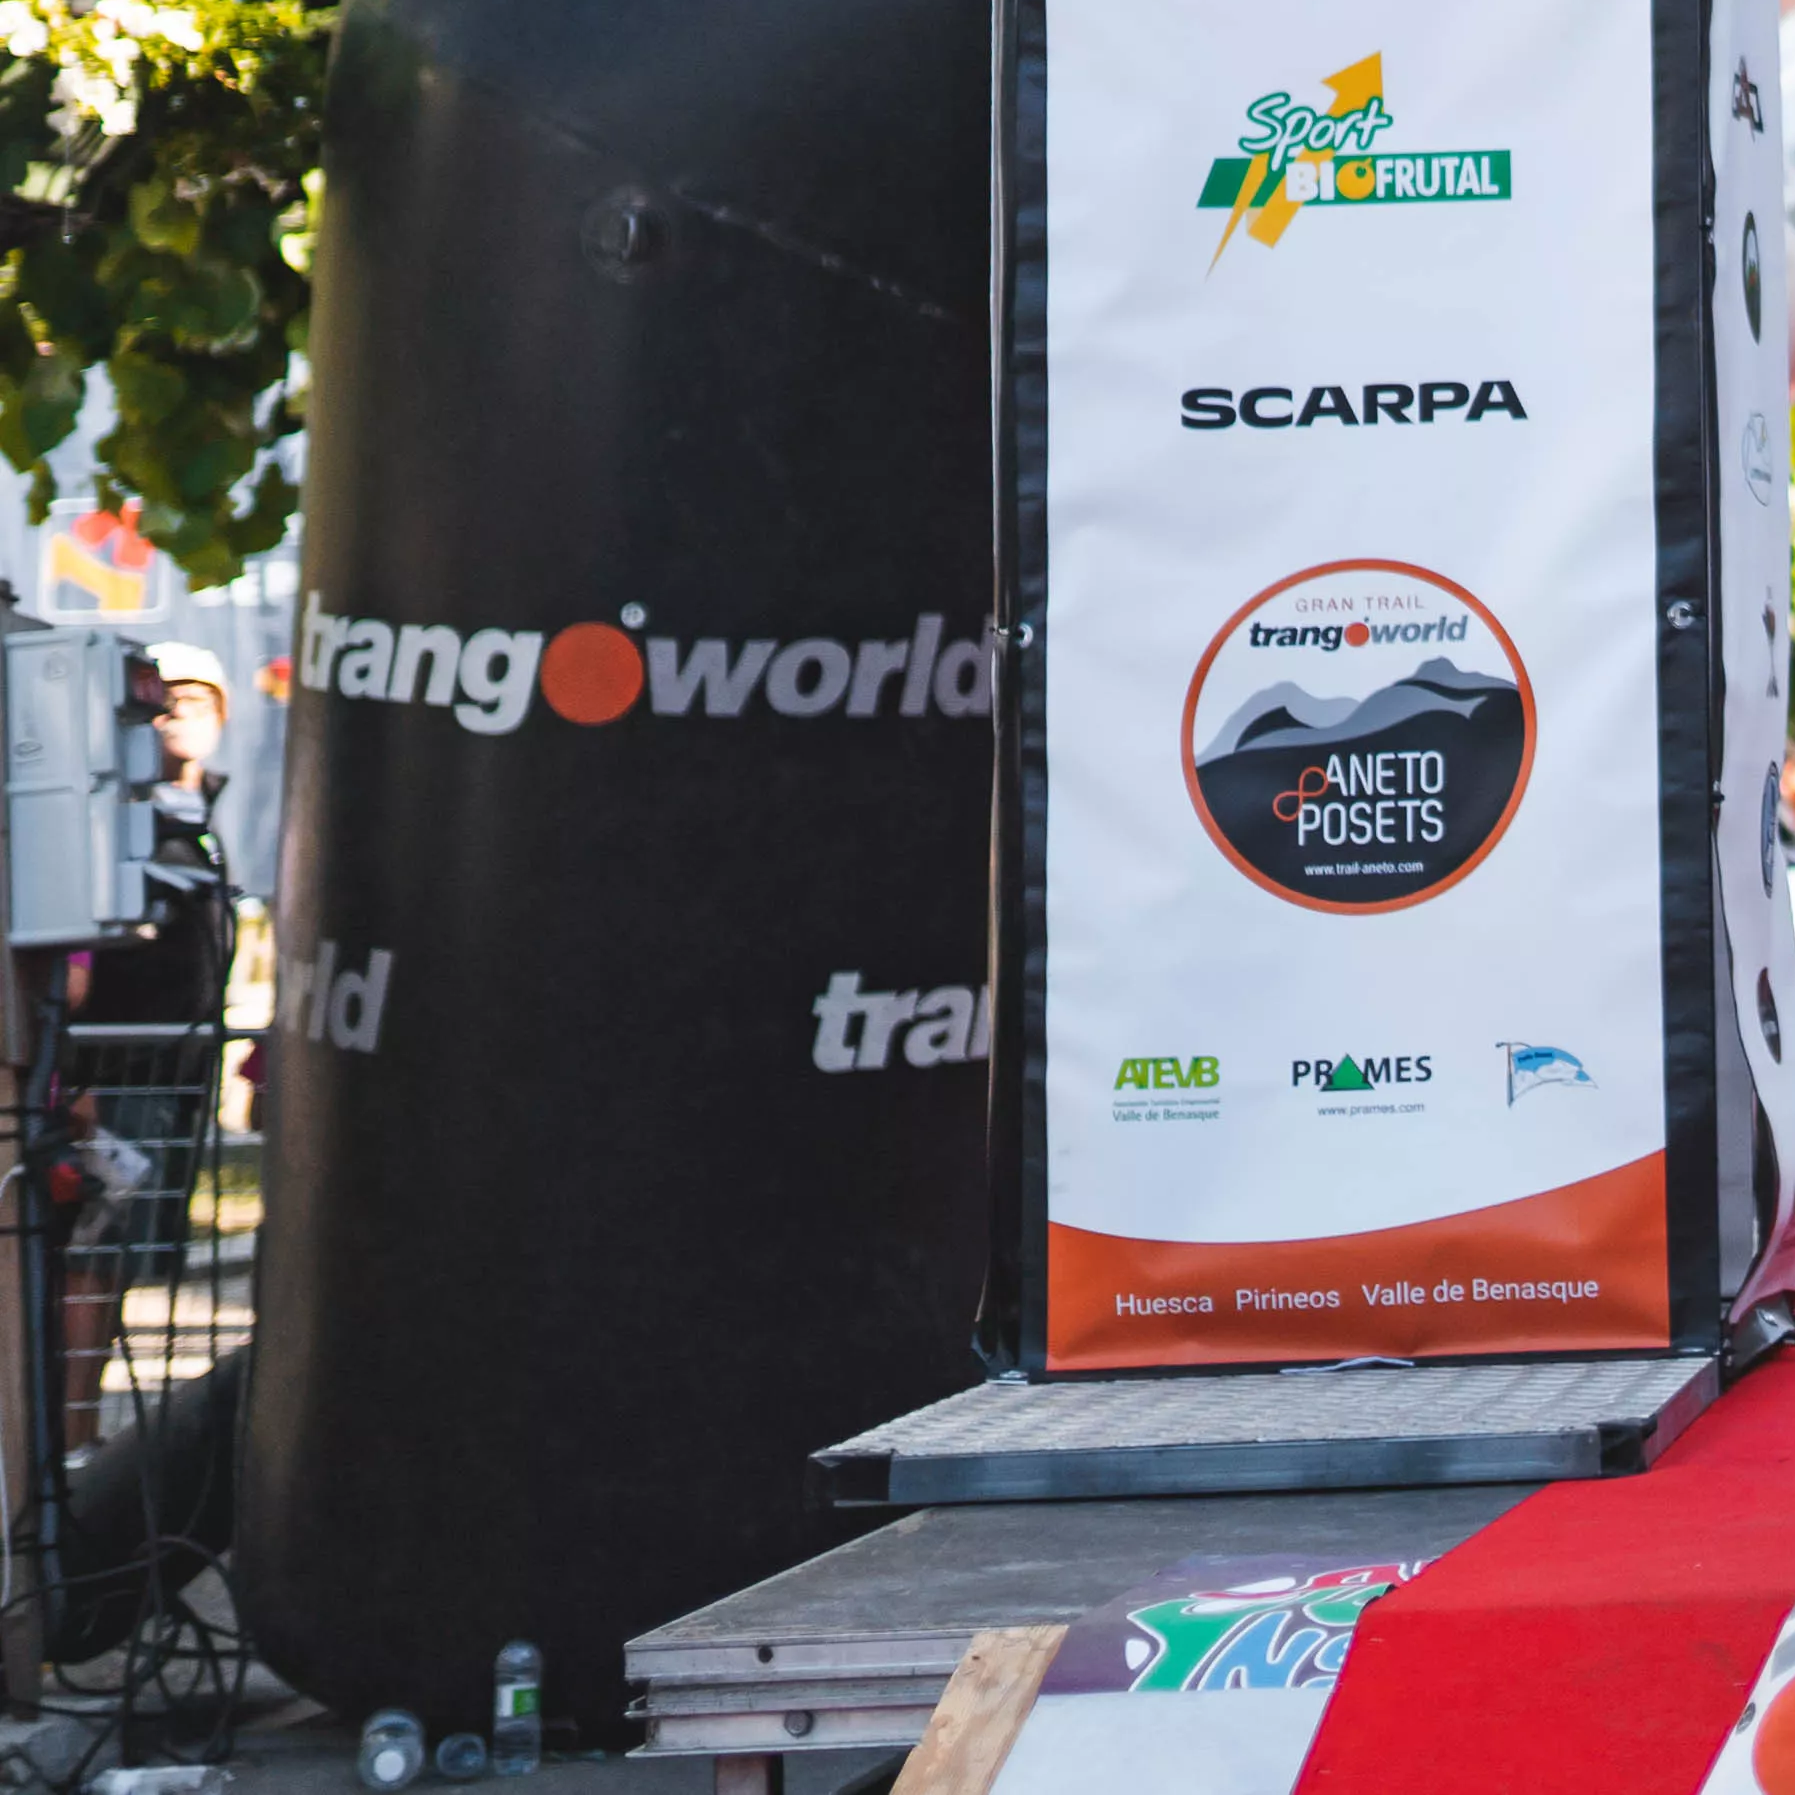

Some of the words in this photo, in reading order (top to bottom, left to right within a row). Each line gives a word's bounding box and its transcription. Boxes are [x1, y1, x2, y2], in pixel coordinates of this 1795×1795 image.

[1240, 92, 1392, 172] Sport
[1285, 157, 1499, 202] BIOFRUTAL
[1181, 380, 1528, 430] SCARPA
[1296, 598, 1354, 613] GRAN
[1365, 595, 1424, 610] TRAIL
[1326, 751, 1443, 796] ANETO
[1298, 799, 1444, 846] POSETS
[1304, 860, 1424, 877] www.trail-aneto.com
[1113, 1109, 1142, 1122] Valle
[1145, 1109, 1159, 1121] de
[1163, 1108, 1220, 1122] Benasque
[1317, 1101, 1425, 1117] www.prames.com
[1116, 1292, 1213, 1316] Huesca
[1235, 1287, 1340, 1311] Pirineos
[1361, 1282, 1425, 1307] Valle
[1433, 1279, 1464, 1303] de
[1472, 1277, 1599, 1306] Benasque
